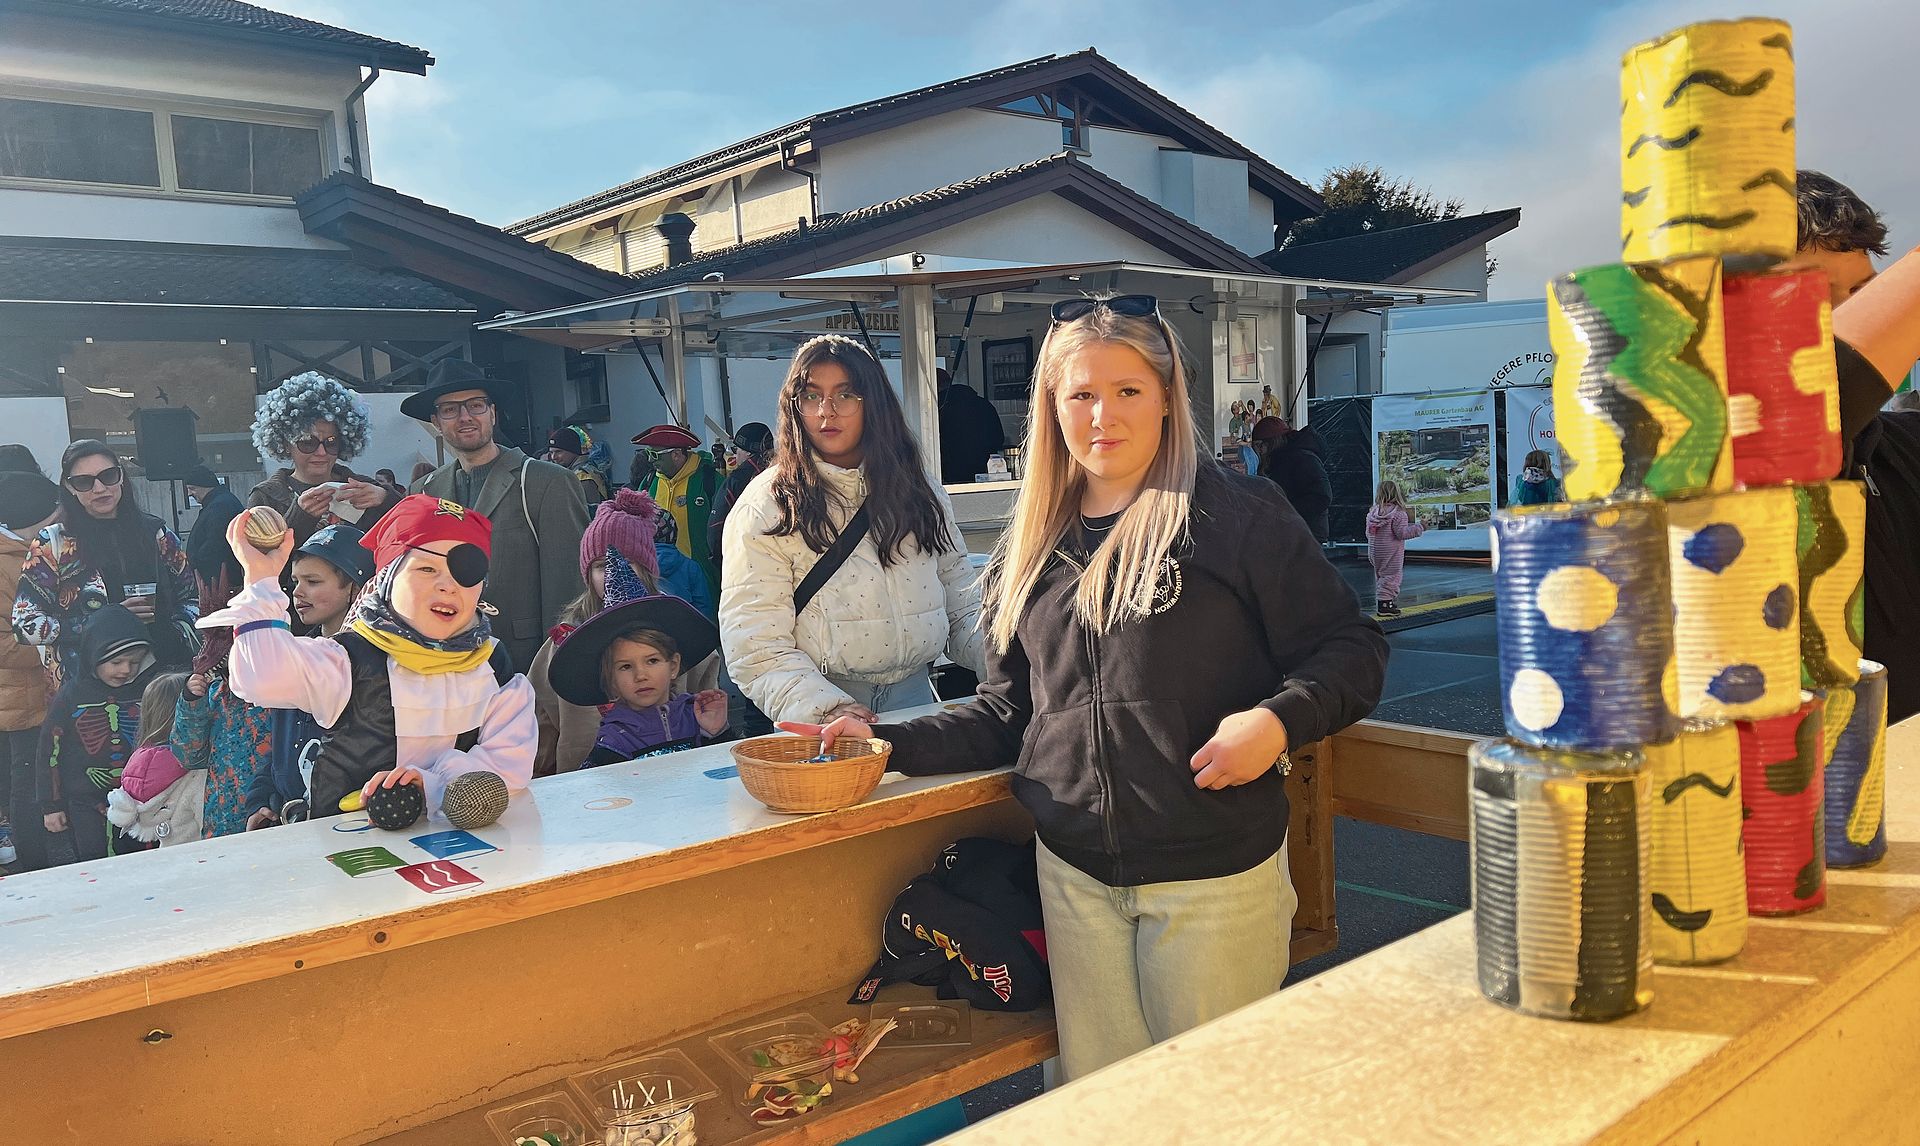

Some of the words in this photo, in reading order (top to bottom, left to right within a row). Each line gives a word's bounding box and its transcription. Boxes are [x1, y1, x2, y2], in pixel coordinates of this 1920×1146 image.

[1414, 408, 1441, 417] MAURER
[1441, 406, 1473, 415] Gartenbau
[1473, 404, 1485, 412] AG
